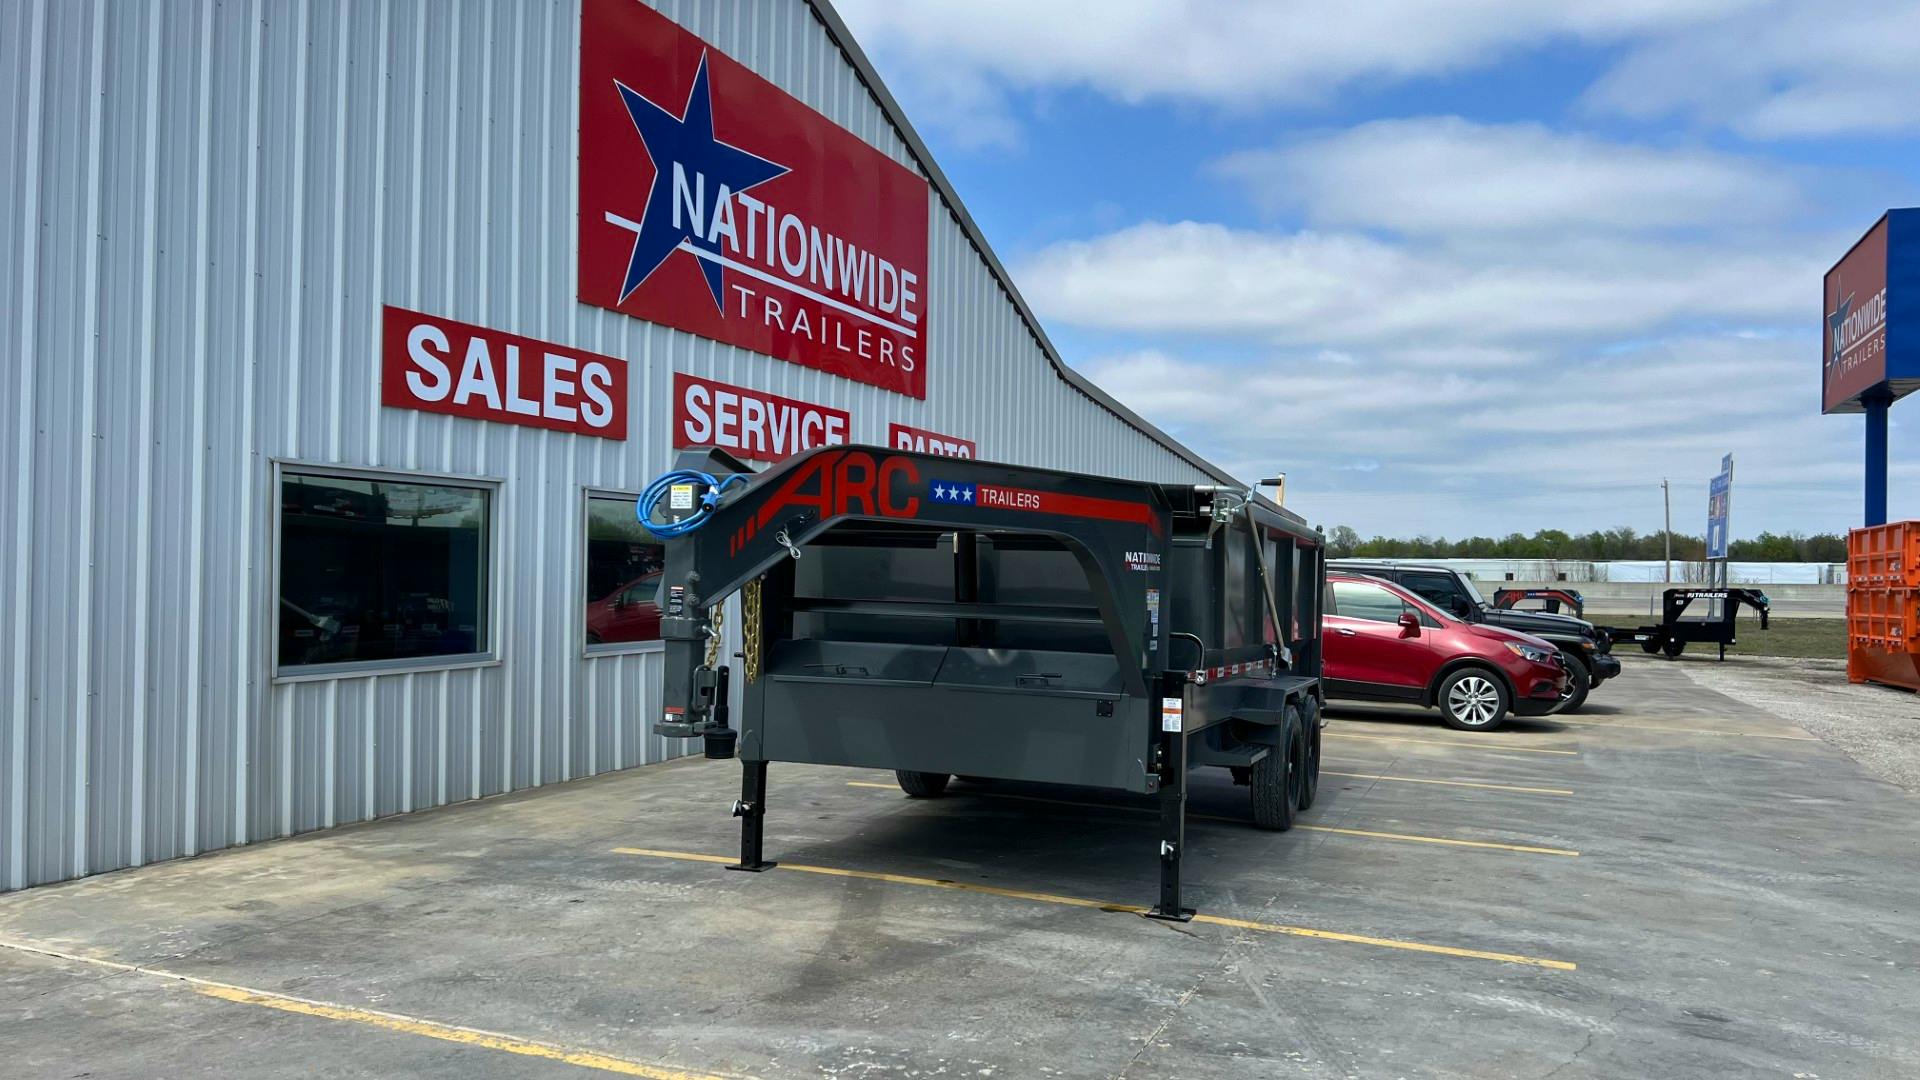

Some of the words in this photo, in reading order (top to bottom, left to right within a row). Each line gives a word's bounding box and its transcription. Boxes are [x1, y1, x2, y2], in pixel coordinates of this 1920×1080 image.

[672, 161, 917, 325] NATIONWIDE
[731, 284, 915, 372] TRAILERS
[1834, 287, 1887, 353] NATIONWIDE
[1842, 333, 1887, 374] TRAILERS
[405, 324, 613, 428] SALES
[684, 384, 844, 456] SERVICE
[757, 450, 920, 528] ARC
[982, 488, 1040, 509] TRAILERS
